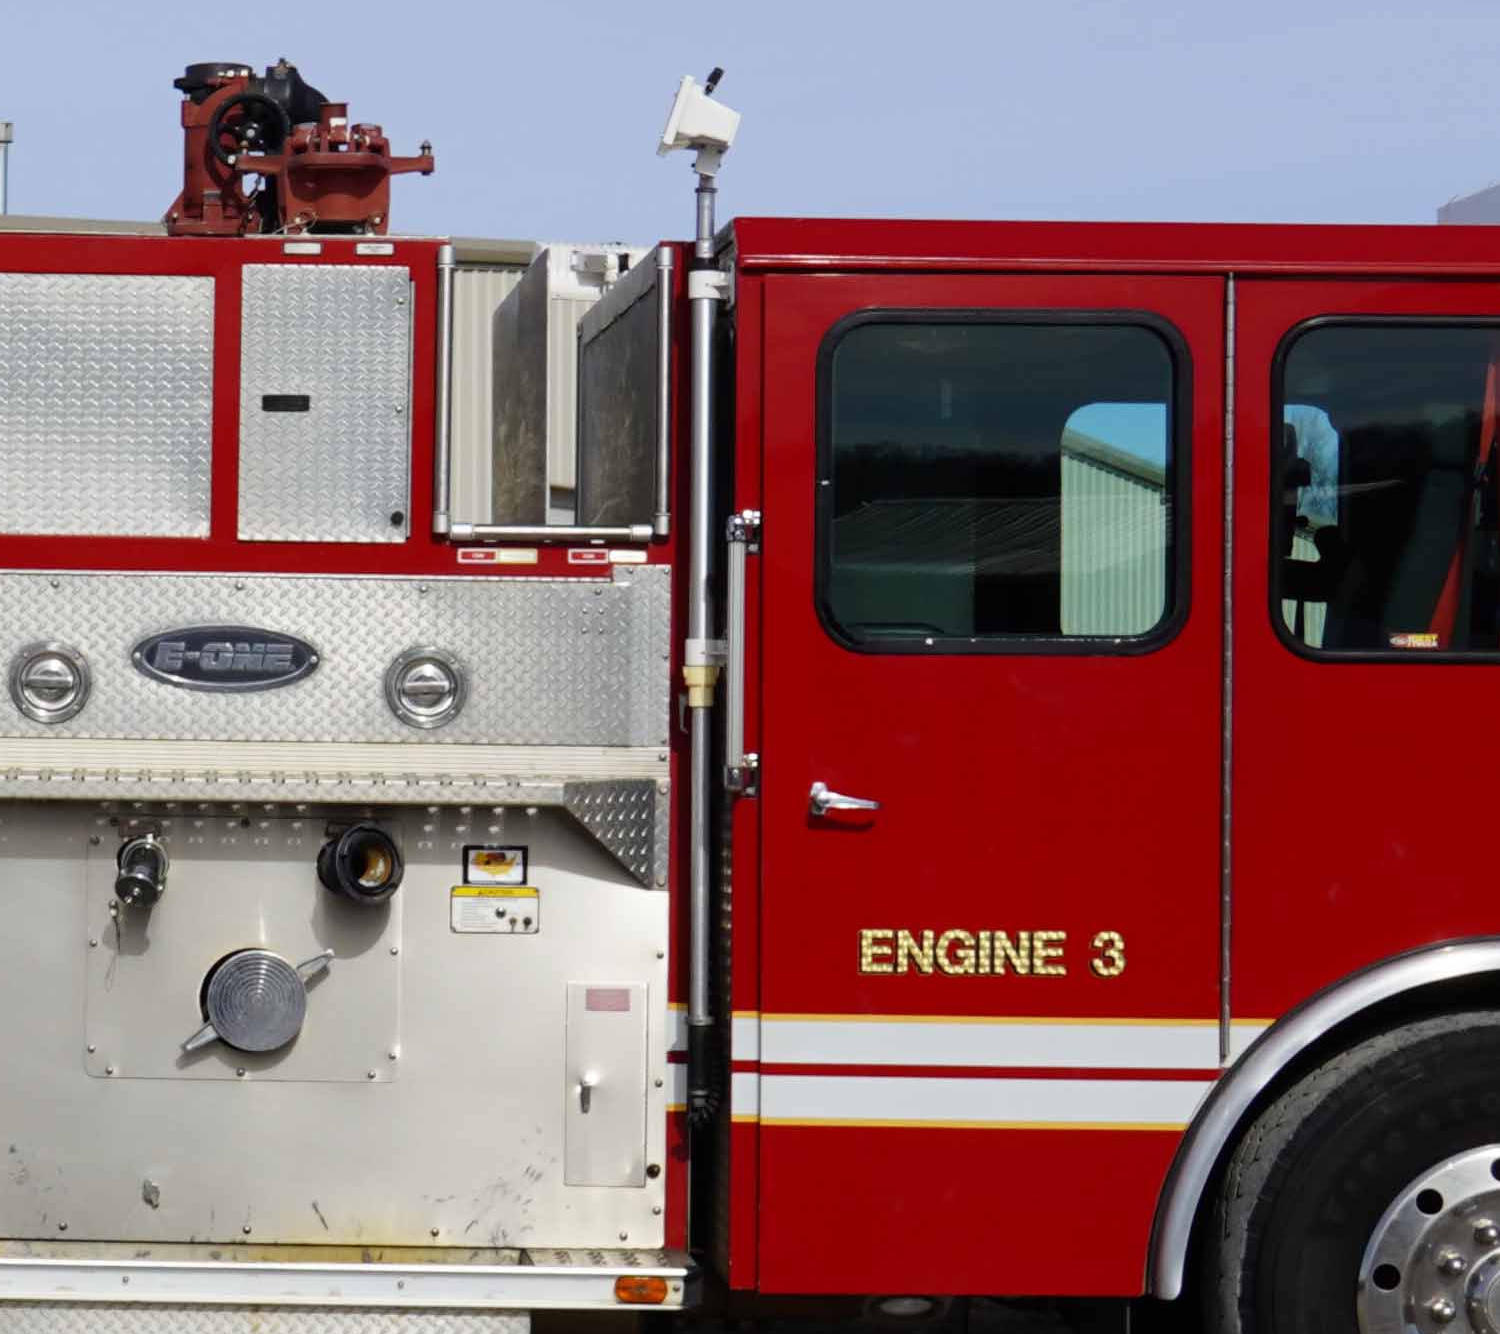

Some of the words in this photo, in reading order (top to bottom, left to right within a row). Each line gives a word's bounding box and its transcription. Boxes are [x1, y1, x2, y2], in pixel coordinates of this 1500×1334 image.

[152, 641, 298, 672] E-ONE
[858, 928, 1068, 976] ENGINE
[1089, 930, 1127, 978] 3
